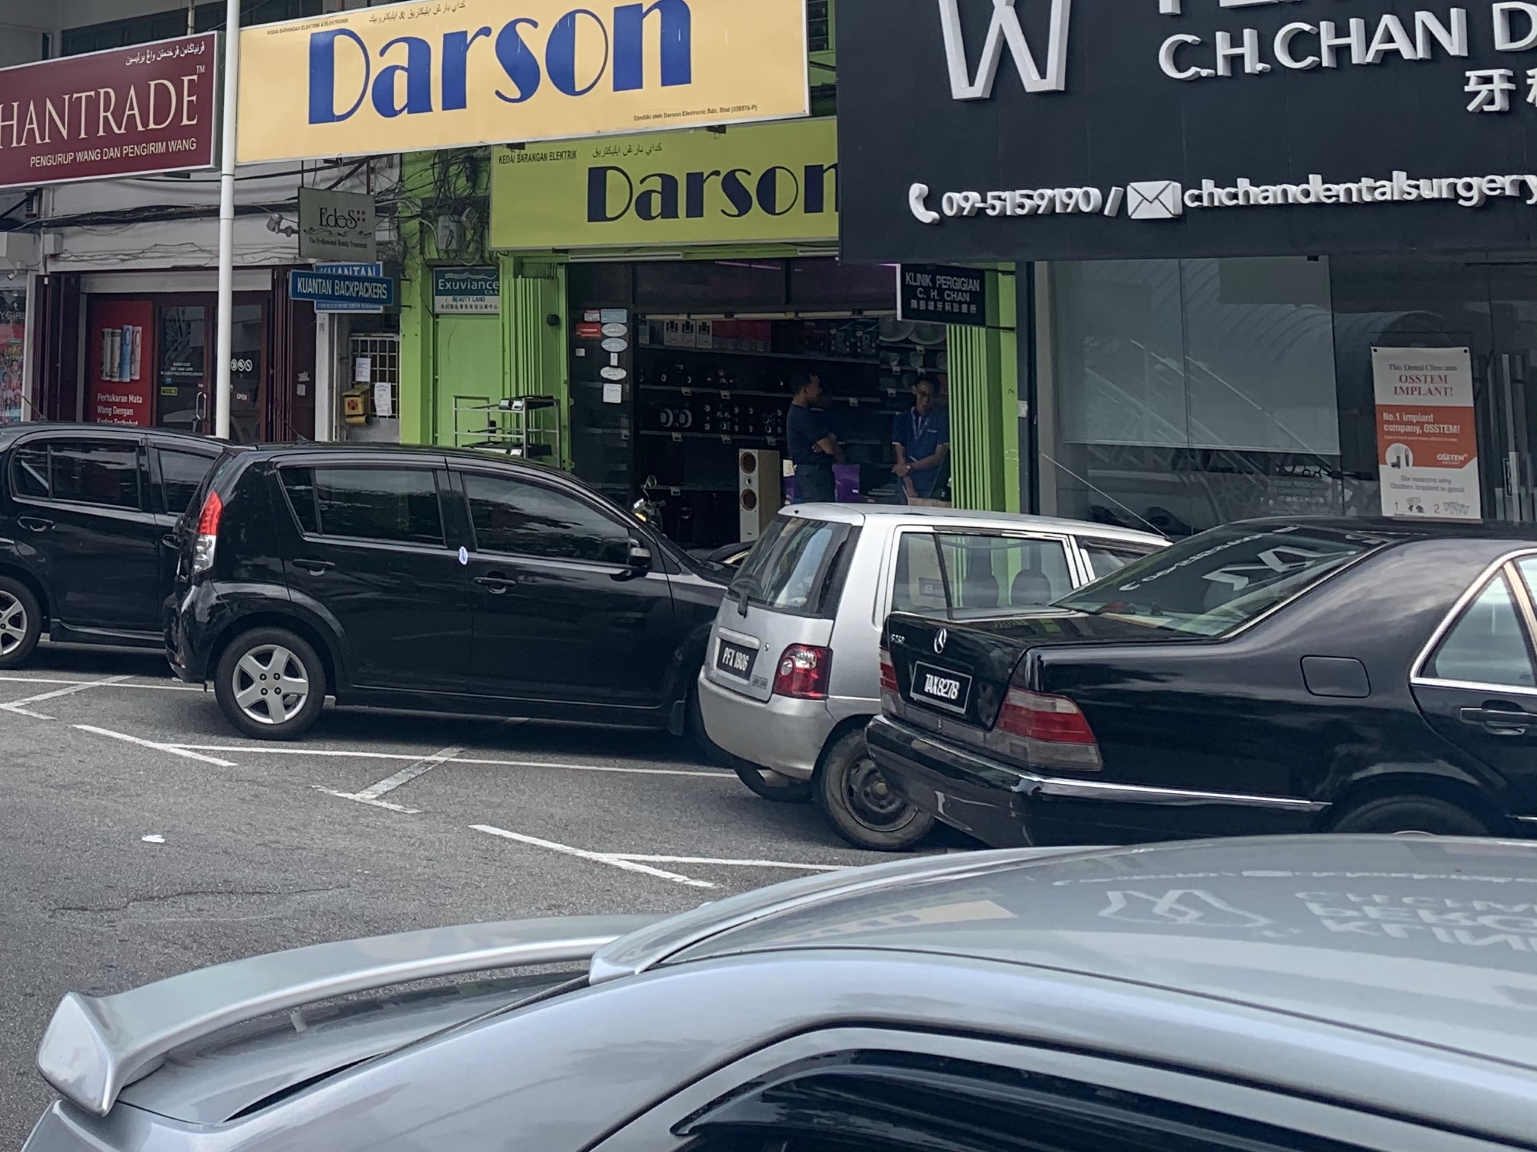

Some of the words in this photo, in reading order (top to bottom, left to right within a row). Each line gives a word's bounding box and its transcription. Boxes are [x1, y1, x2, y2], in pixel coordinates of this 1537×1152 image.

[1463, 67, 1537, 113] 牙
[30, 152, 75, 168] PENGURUP
[75, 149, 101, 163] WANG
[103, 147, 121, 160] DAN
[122, 142, 166, 158] PENGIRIM
[168, 138, 197, 152] WANG
[498, 153, 516, 165] KEDAI
[516, 151, 548, 164] BARANGAN
[549, 150, 578, 162] ELEKTRIK
[587, 160, 840, 223] Darson
[941, 186, 1103, 217] 09-5159190
[438, 279, 499, 290] Exuviance
[905, 272, 932, 287] KLINIK
[936, 275, 980, 291] PERGIGIAN
[297, 277, 332, 295] KUANTAN
[334, 280, 388, 299] BACKPACKERS
[944, 290, 970, 302] CHAN
[1404, 363, 1424, 372] Dental
[1425, 364, 1444, 372] Clinic
[1399, 373, 1448, 385] OSSTEM
[1393, 385, 1453, 397] IMPLANT!
[97, 393, 128, 403] Pertukaran
[128, 394, 143, 403] Mata
[97, 405, 112, 417] Wang
[113, 407, 134, 417] Dengan
[1382, 412, 1400, 421] No.1
[1402, 412, 1434, 424] implant
[1383, 424, 1423, 435] company,
[1423, 424, 1461, 434] OSSTEM!
[1411, 476, 1438, 484] reasons
[1438, 477, 1452, 485] why
[1447, 486, 1465, 494] good
